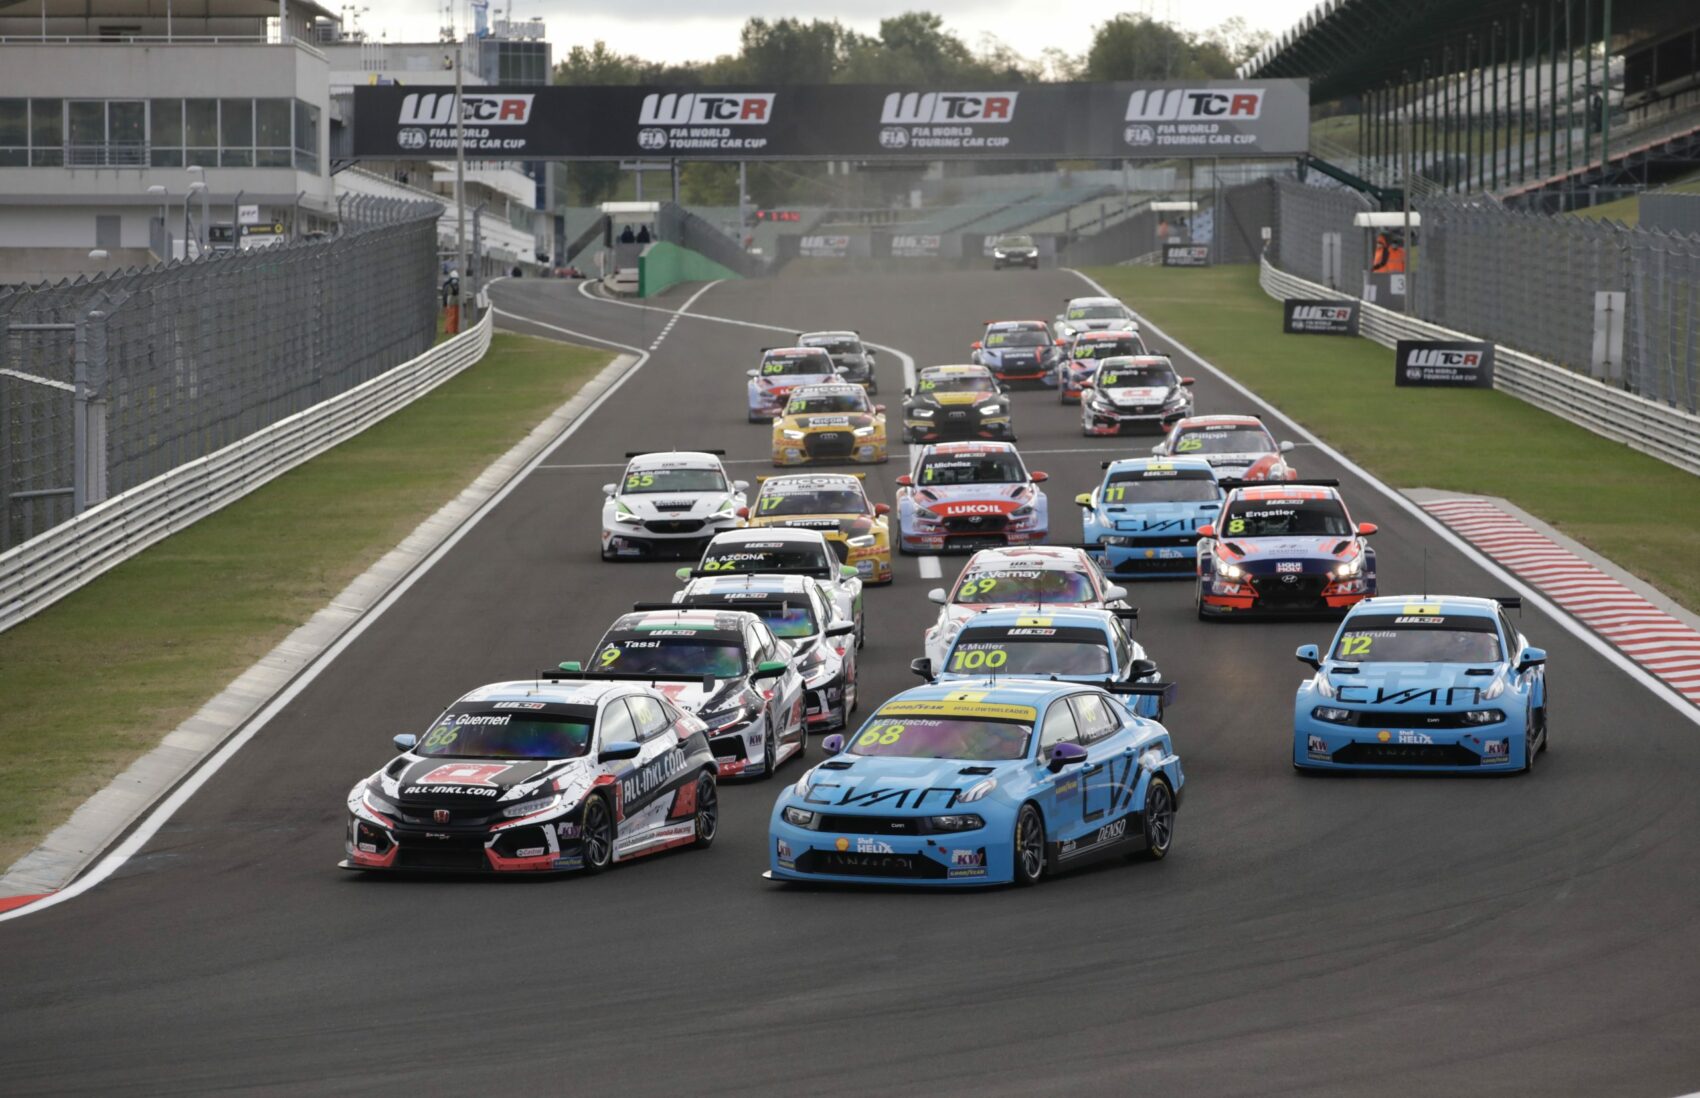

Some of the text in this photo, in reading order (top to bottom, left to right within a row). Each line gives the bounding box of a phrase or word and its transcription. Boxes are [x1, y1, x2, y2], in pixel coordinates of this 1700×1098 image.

[638, 93, 776, 125] WTCR
[880, 91, 1019, 123] WTCR
[1125, 88, 1266, 121] WTCR
[429, 128, 448, 138] FIA
[669, 128, 731, 138] FIA WORLD
[911, 127, 973, 137] FIA WORLD
[1156, 124, 1219, 134] FIA WORLD
[429, 139, 526, 149] TOURNG CAR CUP
[669, 138, 767, 149] TOURING CAR CUP
[911, 137, 1010, 148] TOURING CAR CUP
[1156, 134, 1257, 145] TOURING CAR CUP
[1292, 305, 1352, 320] WTCR
[1406, 348, 1483, 369] WTCR
[763, 363, 784, 374] 30
[1177, 439, 1203, 451] 25
[924, 469, 933, 480] 1
[627, 475, 654, 488] 55
[1106, 486, 1125, 502] 11
[761, 497, 785, 510] 17
[948, 505, 1002, 514] LUKOIL
[1245, 509, 1296, 519] Engstler
[1228, 519, 1246, 534] 8
[719, 552, 766, 561] AZCONA
[959, 578, 997, 596] 69
[624, 640, 661, 649] Tassi
[957, 643, 1005, 651] Y.Muller
[1340, 636, 1373, 656] 12
[600, 648, 622, 667] 9
[953, 650, 1008, 670] 100
[425, 726, 462, 747] 86
[858, 725, 905, 746] 68
[1398, 734, 1435, 745] HELIX
[1097, 818, 1127, 844] DENSO
[857, 841, 894, 854] HELIX
[957, 853, 981, 865] KW
